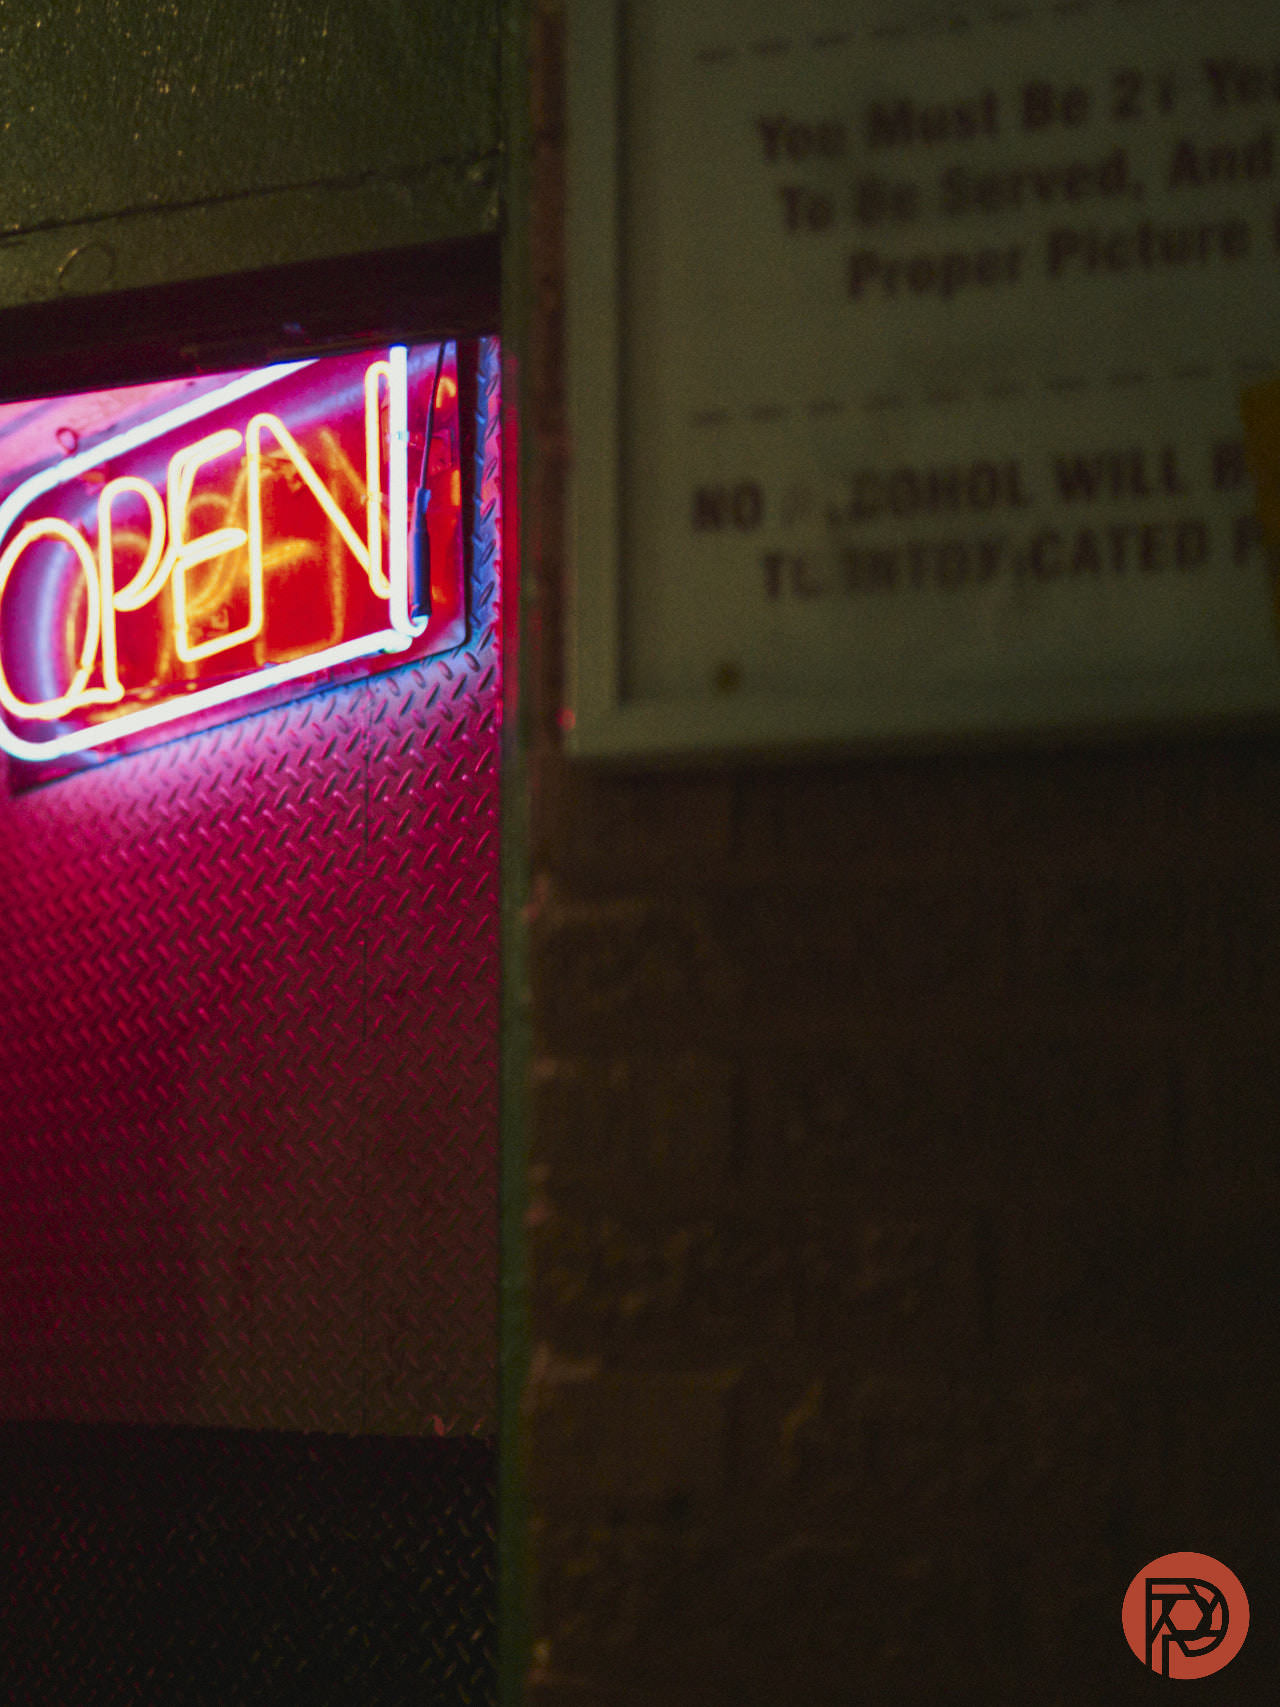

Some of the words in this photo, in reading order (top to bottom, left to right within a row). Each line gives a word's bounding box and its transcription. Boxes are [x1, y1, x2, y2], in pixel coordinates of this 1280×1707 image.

[754, 115, 846, 164] You
[867, 86, 999, 149] Must
[1022, 79, 1091, 132] Be
[779, 184, 835, 234] To
[1169, 128, 1275, 189] And
[847, 245, 1023, 301] Proper
[1048, 219, 1252, 280] Picture
[690, 478, 764, 532] NO
[1053, 448, 1188, 502] WILL
